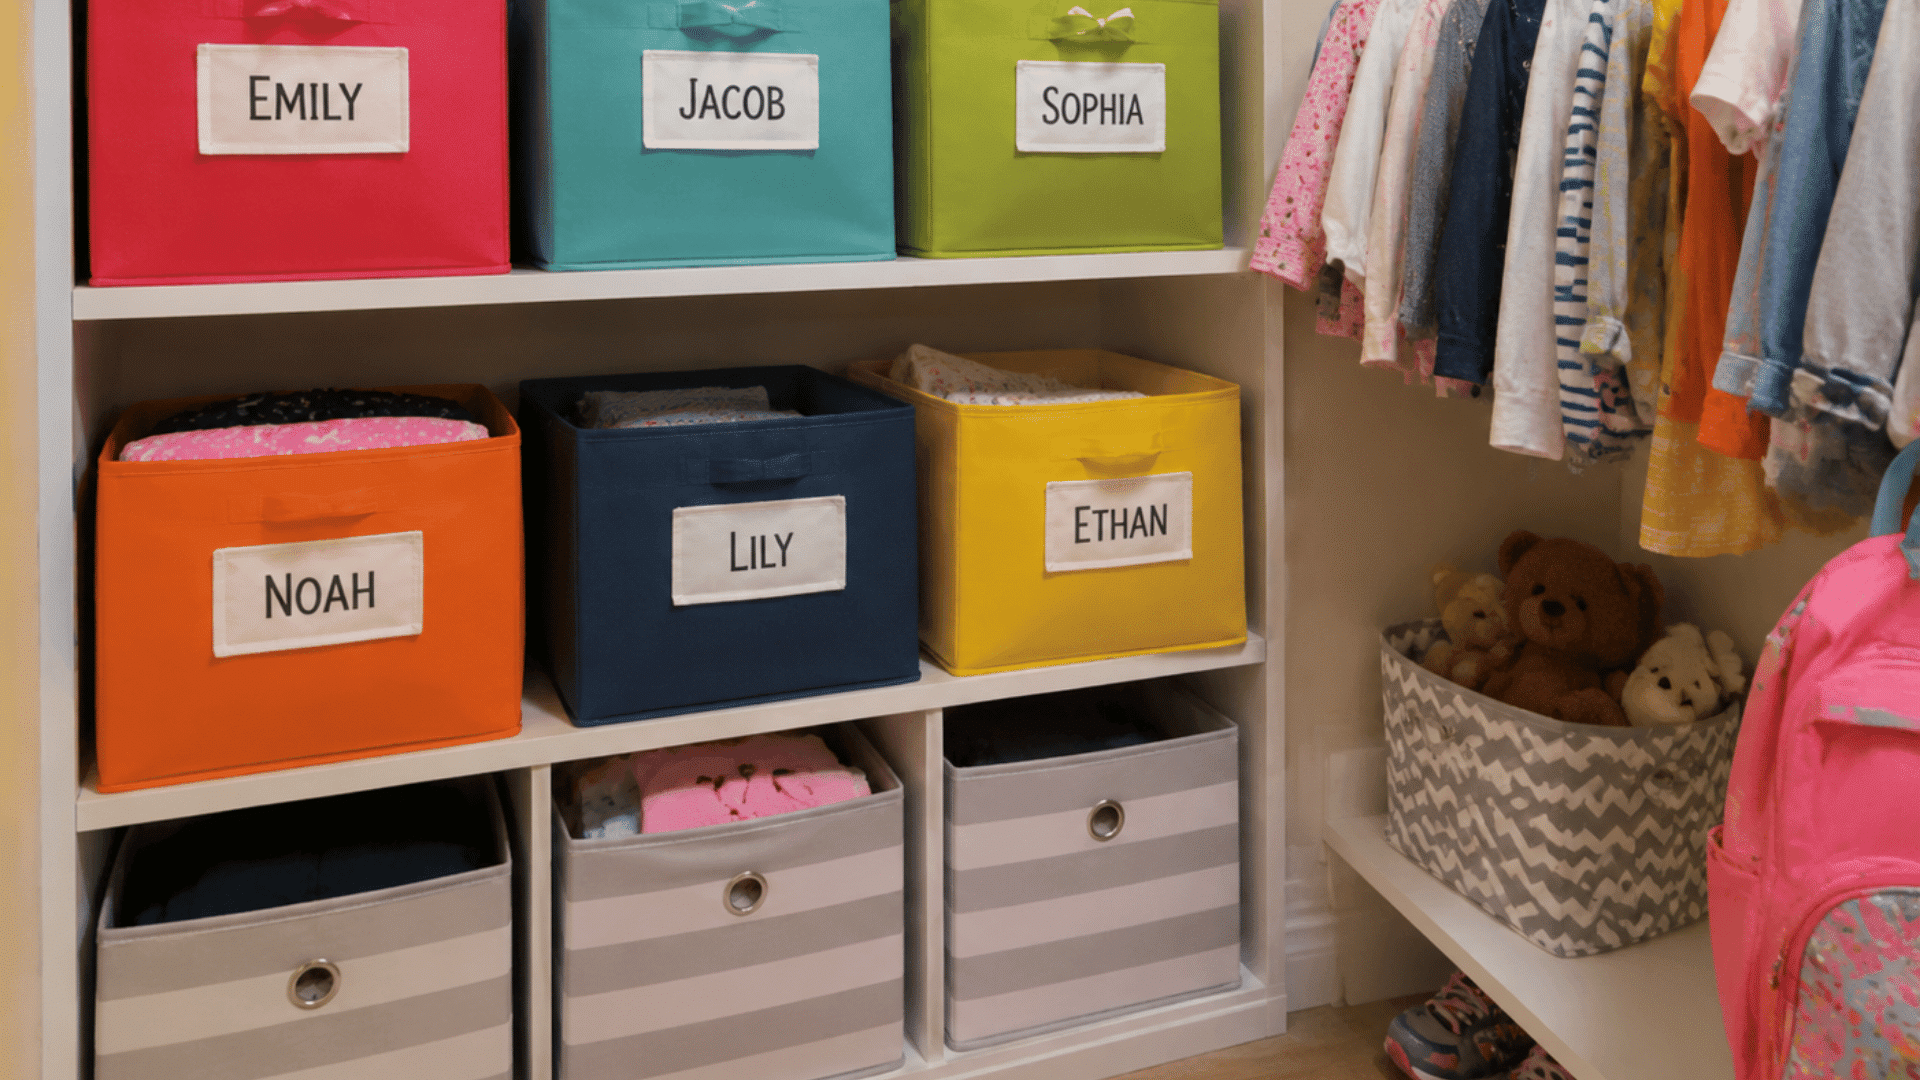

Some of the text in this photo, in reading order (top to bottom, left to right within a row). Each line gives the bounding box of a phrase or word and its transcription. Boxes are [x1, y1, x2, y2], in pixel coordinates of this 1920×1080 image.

[249, 75, 363, 121] EMILY
[679, 77, 786, 121] JACOB
[1042, 86, 1144, 125] SOPHIA
[1074, 503, 1168, 544] ETHAN
[730, 531, 794, 573] LILY
[265, 570, 375, 619] NOAH
